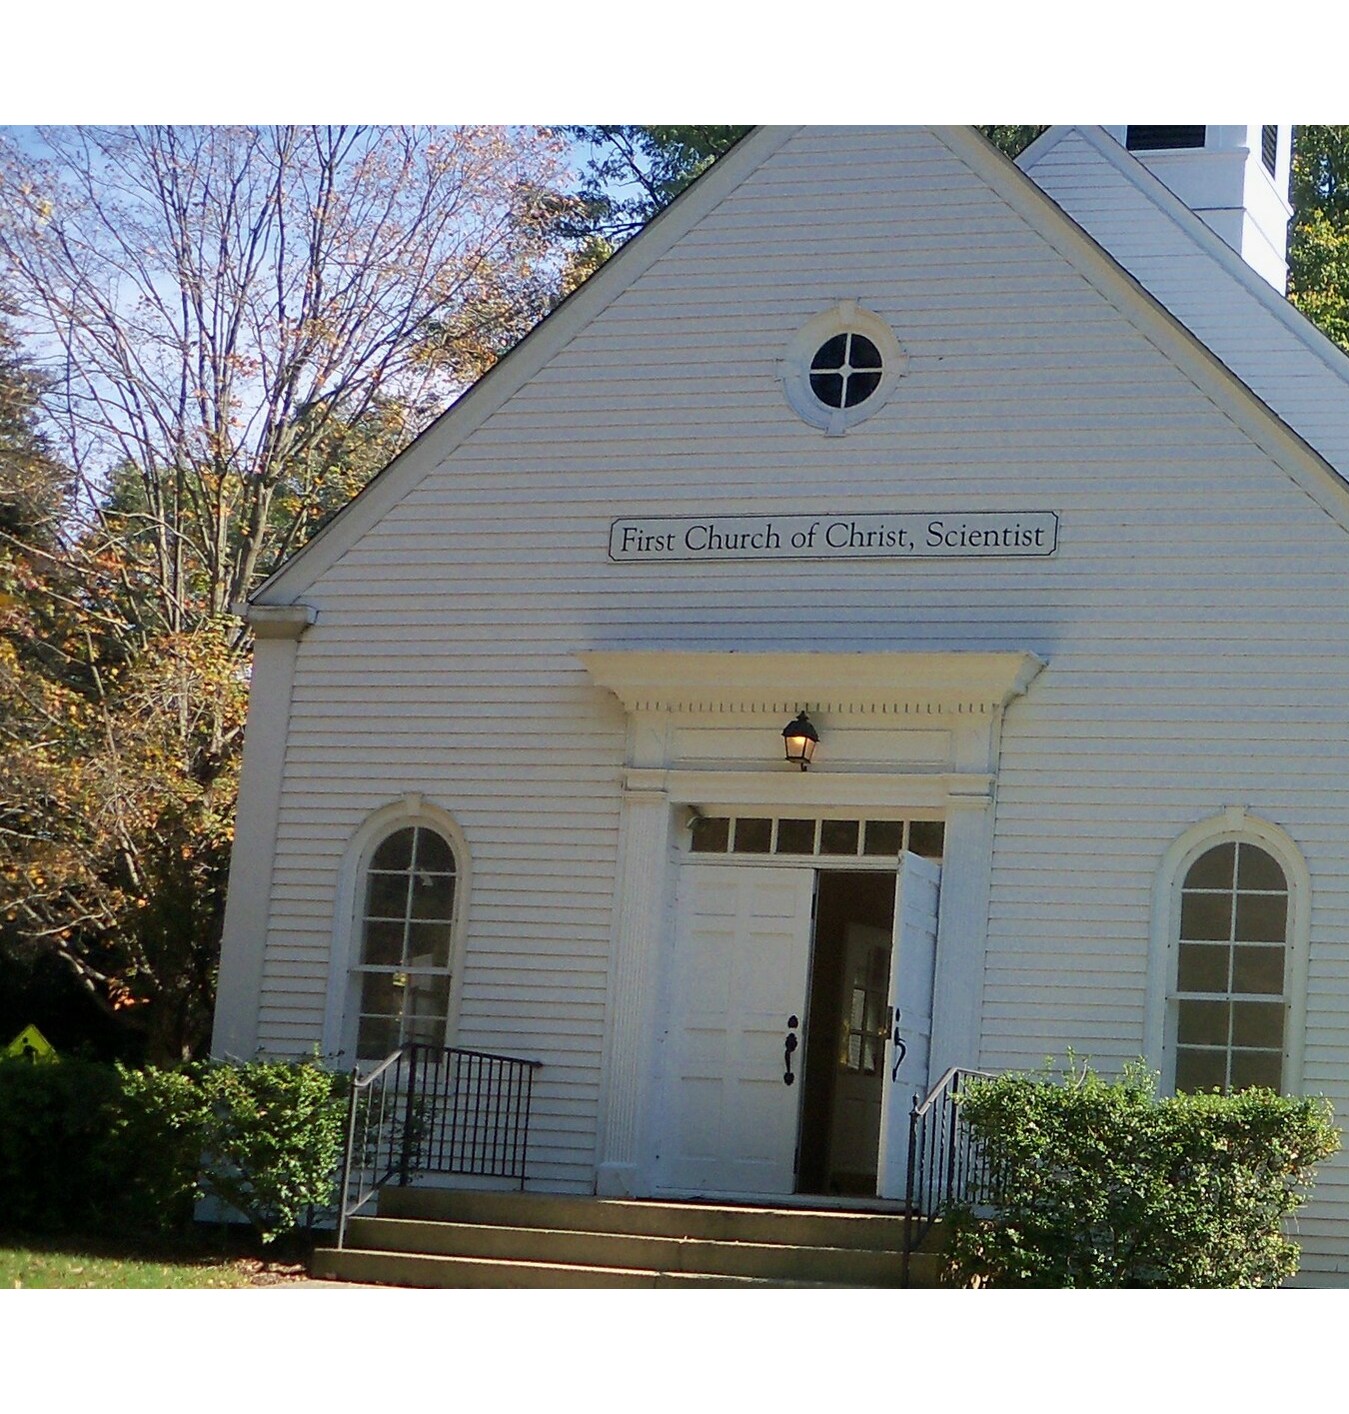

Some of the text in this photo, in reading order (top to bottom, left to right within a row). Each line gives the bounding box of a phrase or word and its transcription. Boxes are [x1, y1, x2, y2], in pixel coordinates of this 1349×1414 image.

[620, 520, 1046, 553] First Church of Christ, Scientist
